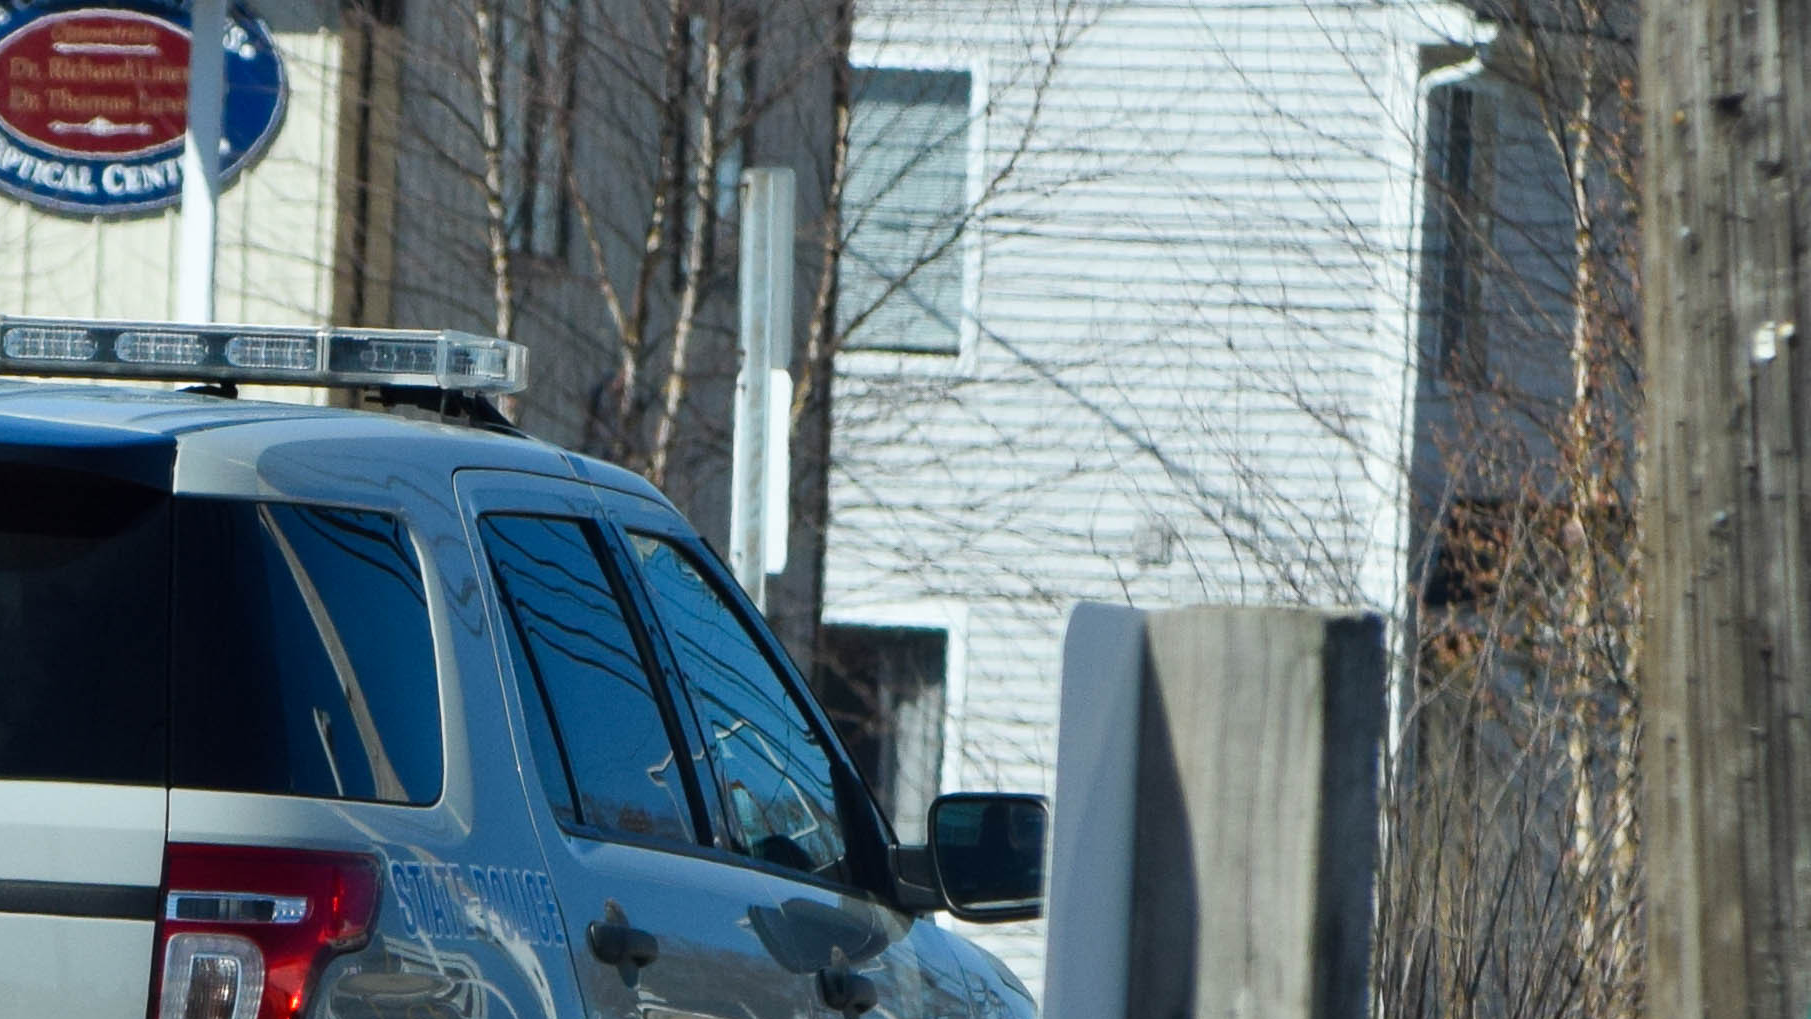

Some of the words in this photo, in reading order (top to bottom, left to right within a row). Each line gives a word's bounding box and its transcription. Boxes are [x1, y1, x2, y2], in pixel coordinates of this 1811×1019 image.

[102, 154, 186, 195] CENT
[390, 859, 461, 939] STATE
[465, 864, 566, 947] POLICE
